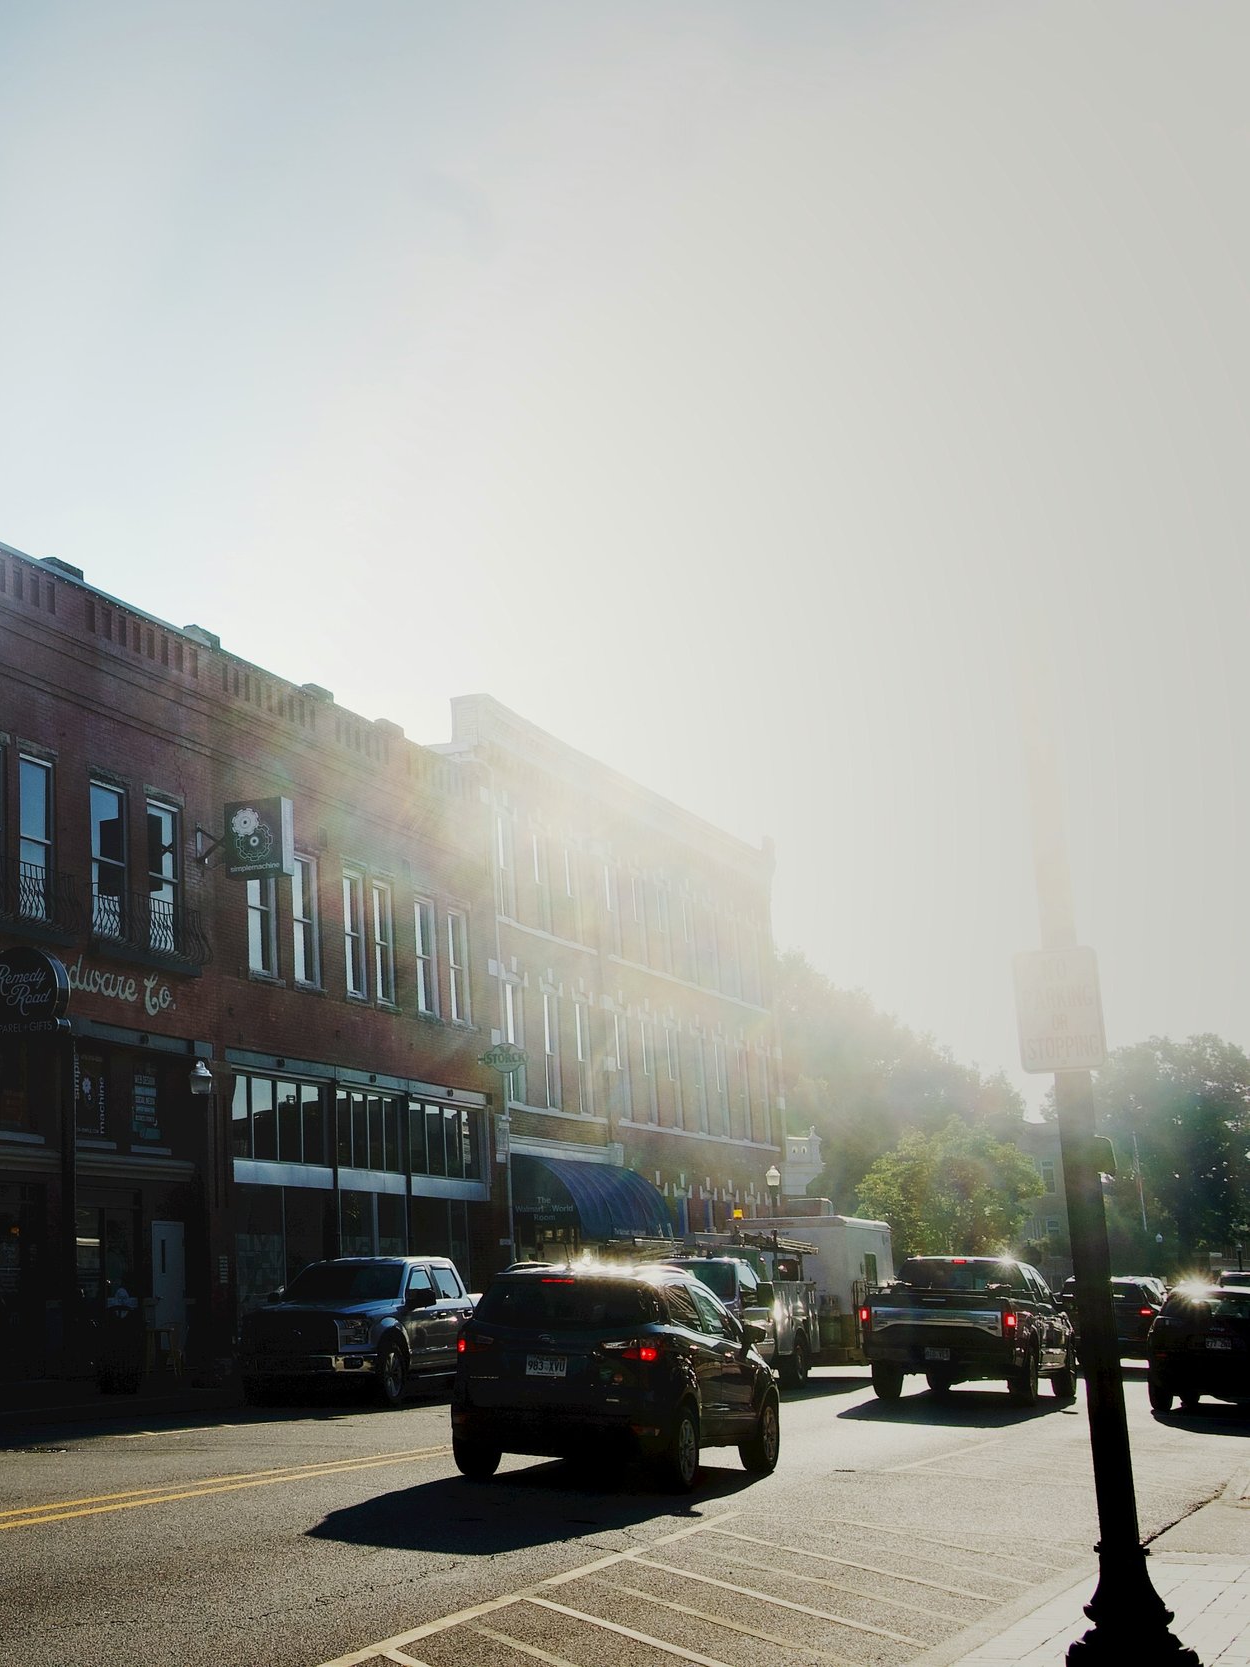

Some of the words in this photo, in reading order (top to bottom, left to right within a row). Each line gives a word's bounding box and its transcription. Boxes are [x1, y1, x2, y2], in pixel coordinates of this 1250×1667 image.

[230, 862, 280, 873] simplemachine
[68, 953, 138, 1002] dware
[144, 971, 176, 1016] Co.
[6, 983, 52, 1016] Road
[1023, 984, 1094, 1009] PARKING
[29, 1020, 53, 1032] GIFTS
[1053, 1013, 1069, 1031] OR
[1027, 1034, 1099, 1061] STOPPING
[536, 1196, 551, 1205] The
[515, 1204, 545, 1213] Walmart
[552, 1203, 574, 1212] World
[533, 1214, 556, 1222] Room
[527, 1360, 544, 1371] 983
[549, 1361, 566, 1372] XVU
